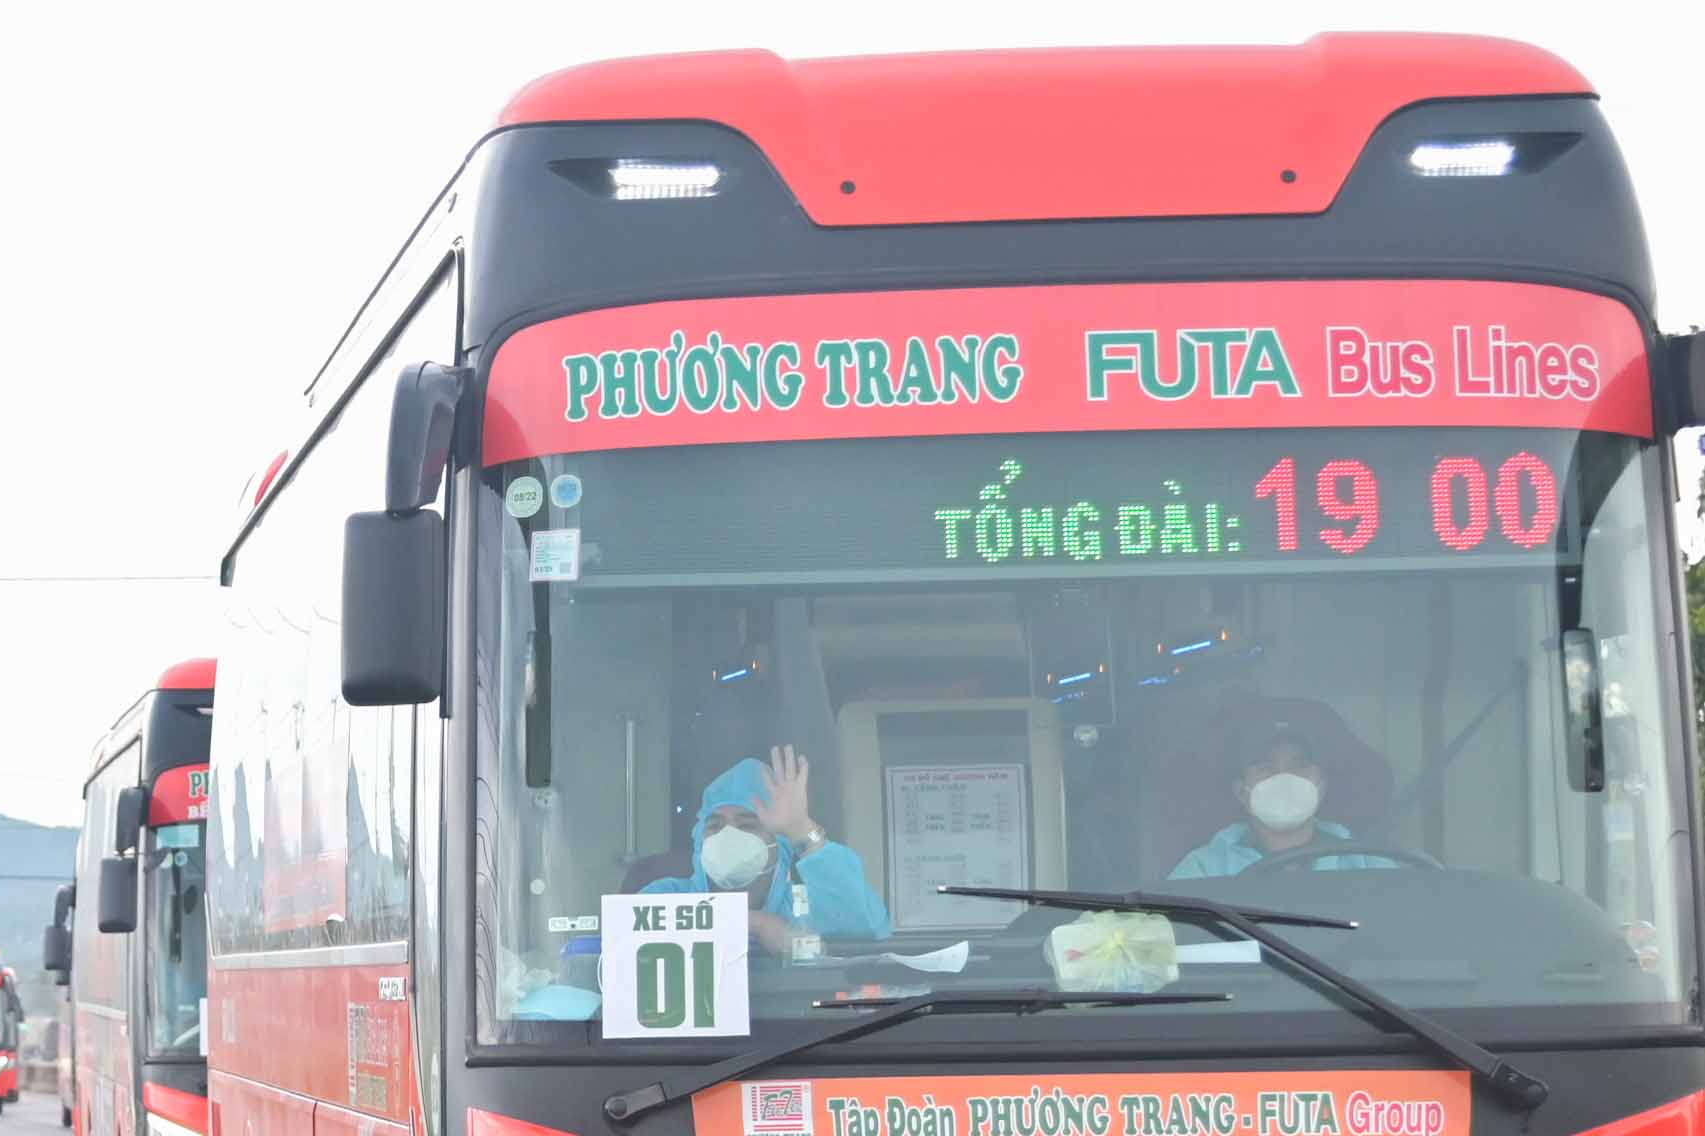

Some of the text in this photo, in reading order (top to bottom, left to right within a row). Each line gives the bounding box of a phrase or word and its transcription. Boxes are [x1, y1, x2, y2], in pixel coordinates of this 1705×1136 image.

[563, 326, 1599, 422] PHƯƠNG TRANG FUTA Bus Lines
[1255, 457, 1382, 554] 19
[1431, 451, 1559, 552] 00
[632, 896, 716, 931] XE SỐ
[636, 941, 716, 1029] 01
[1120, 1094, 1235, 1136] TRANG
[1257, 1092, 1340, 1136] FUTA
